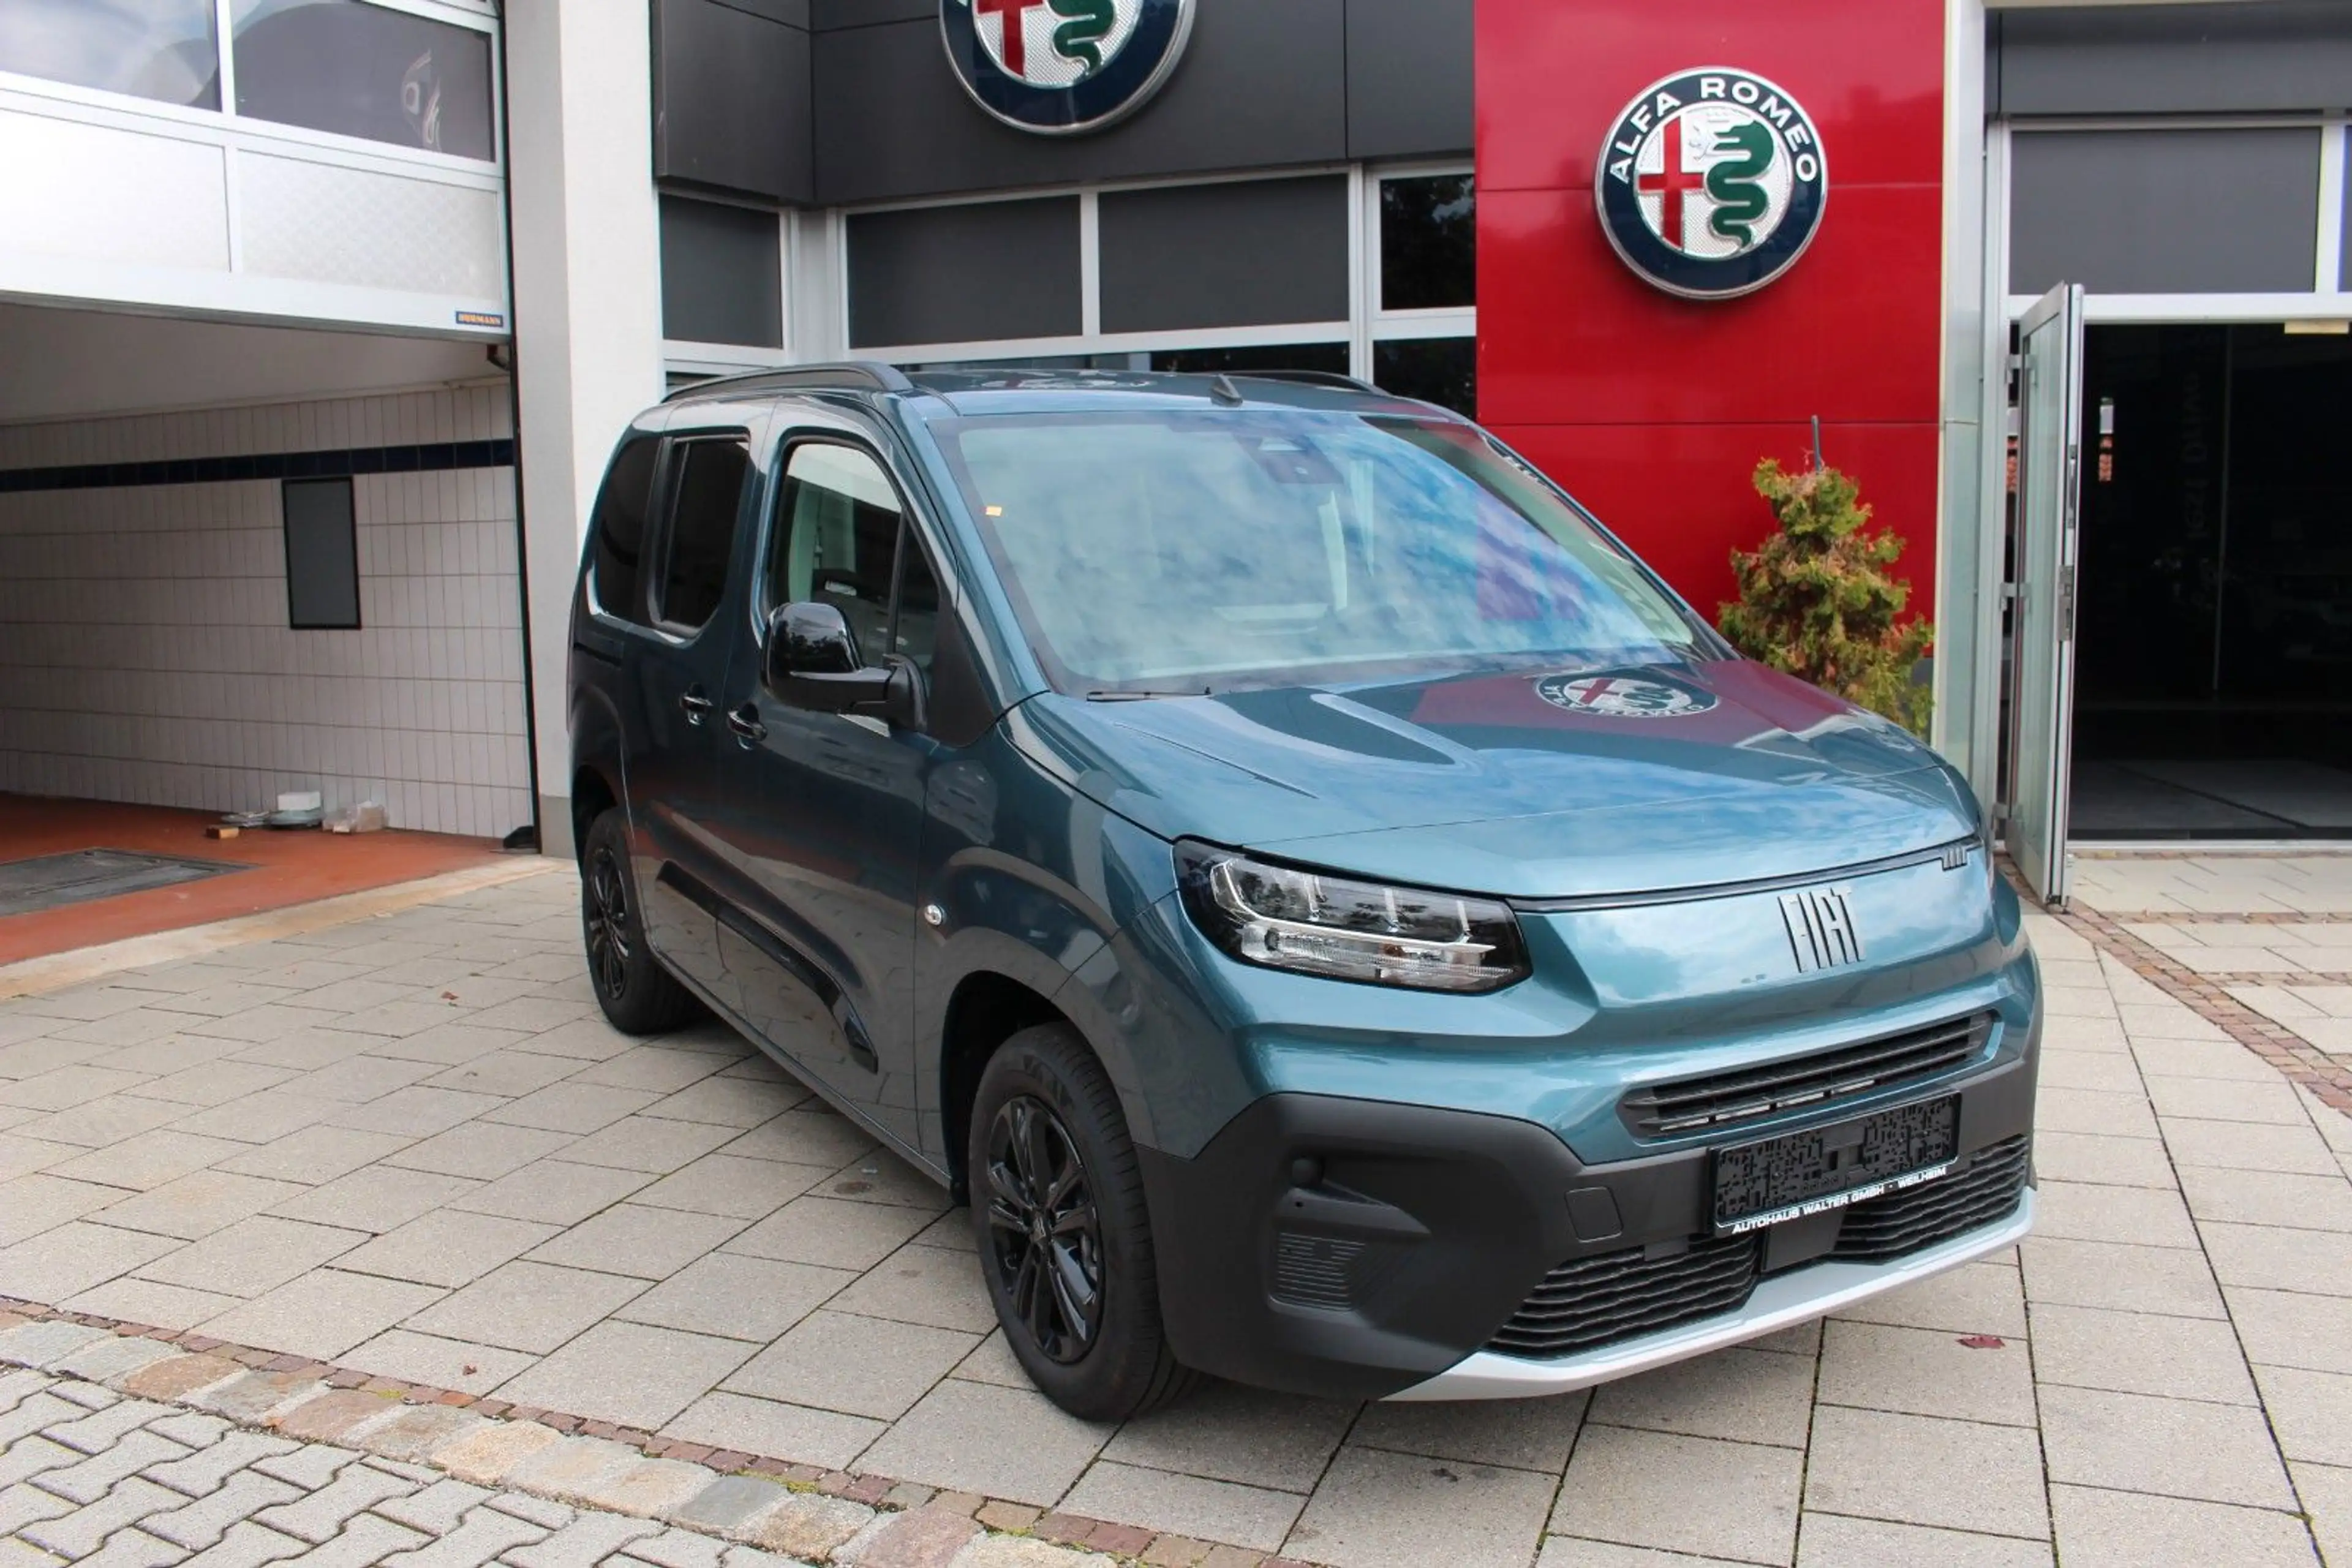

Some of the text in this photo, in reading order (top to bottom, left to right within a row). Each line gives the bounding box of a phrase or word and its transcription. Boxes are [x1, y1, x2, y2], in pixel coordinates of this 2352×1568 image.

[1610, 77, 1817, 184] ALFA ROMEO
[1777, 887, 1866, 973] FIAT
[1732, 1207, 1800, 1234] AUTOHAUS
[1804, 1196, 1848, 1215] WALTER
